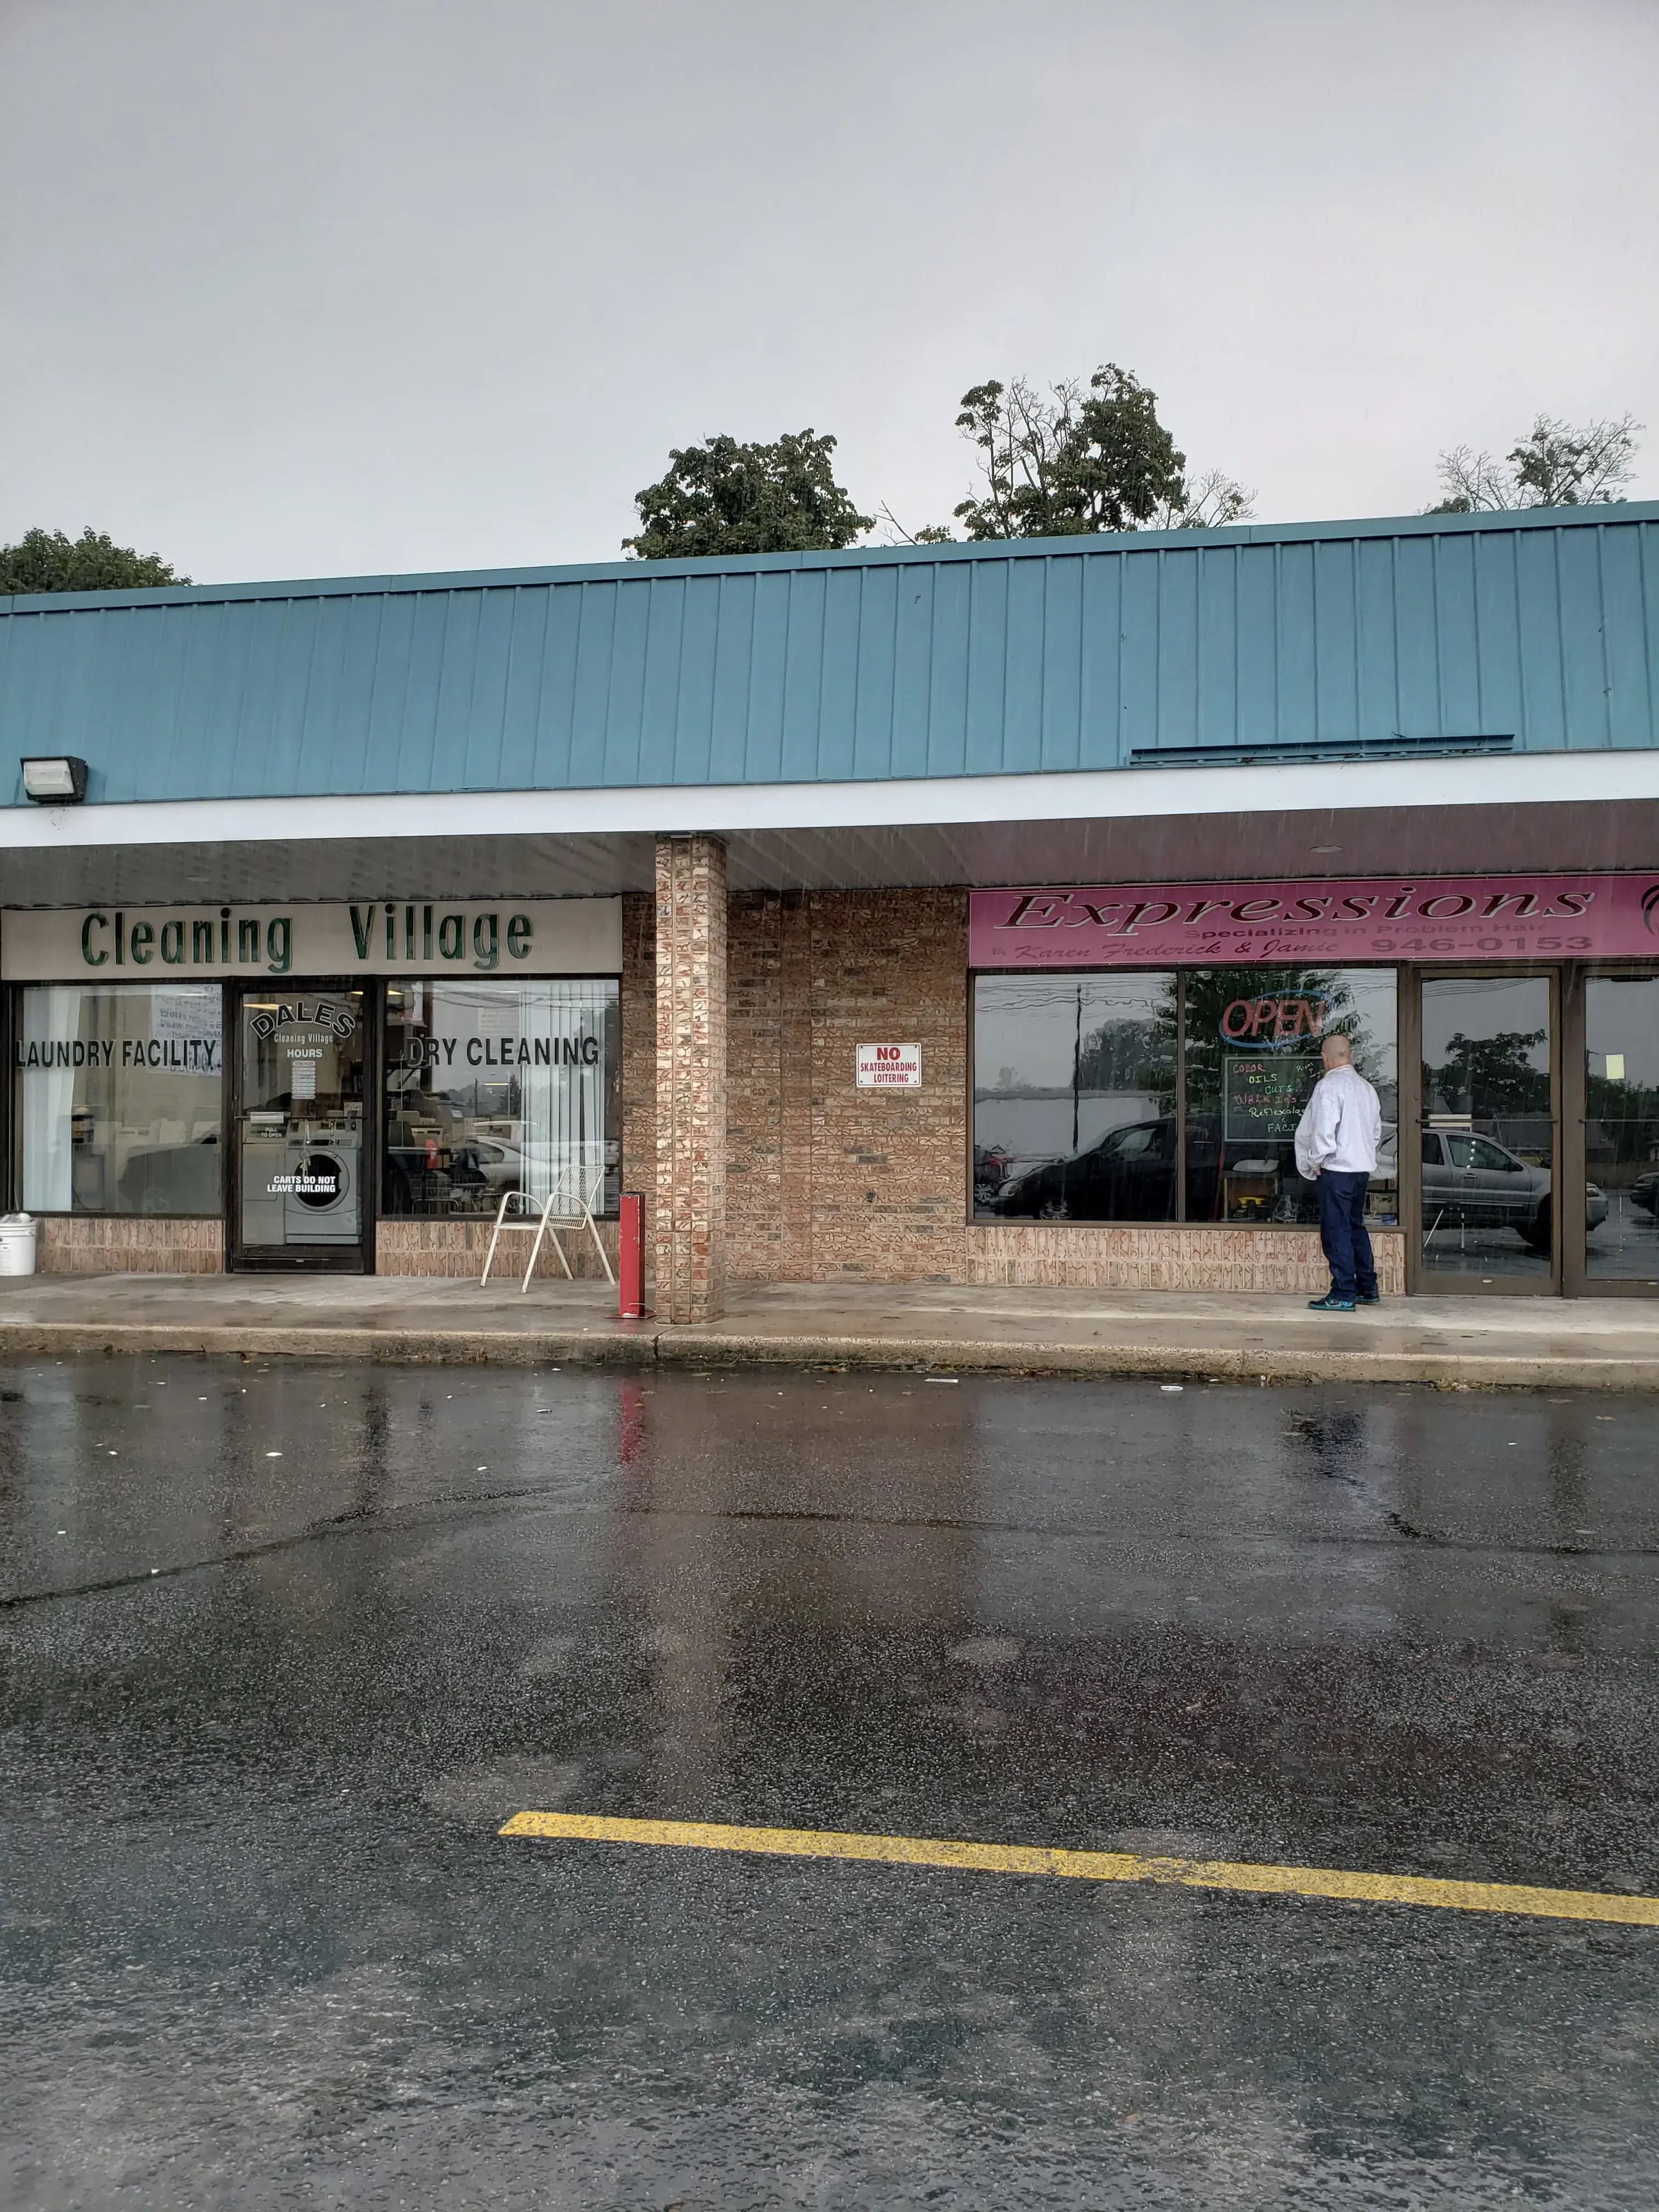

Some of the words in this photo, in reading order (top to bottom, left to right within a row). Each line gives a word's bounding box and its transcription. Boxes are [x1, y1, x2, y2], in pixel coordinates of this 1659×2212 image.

[994, 887, 1595, 936] Expressions
[81, 907, 293, 973] Cleaning
[349, 903, 533, 970] Village
[1184, 927, 1337, 939] Specializing
[1345, 926, 1366, 934] in
[1376, 924, 1482, 934] Problem
[1015, 945, 1091, 959] Karen
[1096, 941, 1222, 959] Frederick
[1234, 941, 1251, 953] &
[1260, 939, 1338, 958] Jamie
[1371, 936, 1593, 952] 946-0153
[250, 1001, 356, 1040] DALES
[1222, 1000, 1325, 1037] OPEN
[274, 1033, 305, 1045] Cleaning
[308, 1033, 334, 1045] Village
[16, 1040, 115, 1068] LAUNDRY
[122, 1039, 217, 1067] FACILITY
[287, 1048, 323, 1058] HOURS
[407, 1037, 458, 1067] DRY
[466, 1037, 599, 1066] CLEANING
[877, 1047, 900, 1060] NO
[860, 1062, 917, 1072] SKATEBOARDING
[1233, 1064, 1269, 1073] COLOR
[874, 1074, 909, 1083] LOITERING
[1249, 1074, 1277, 1084] OILS
[1267, 1124, 1296, 1132] FACI
[274, 1176, 302, 1184] CARTS
[303, 1176, 315, 1184] DO
[318, 1176, 336, 1184] NOT
